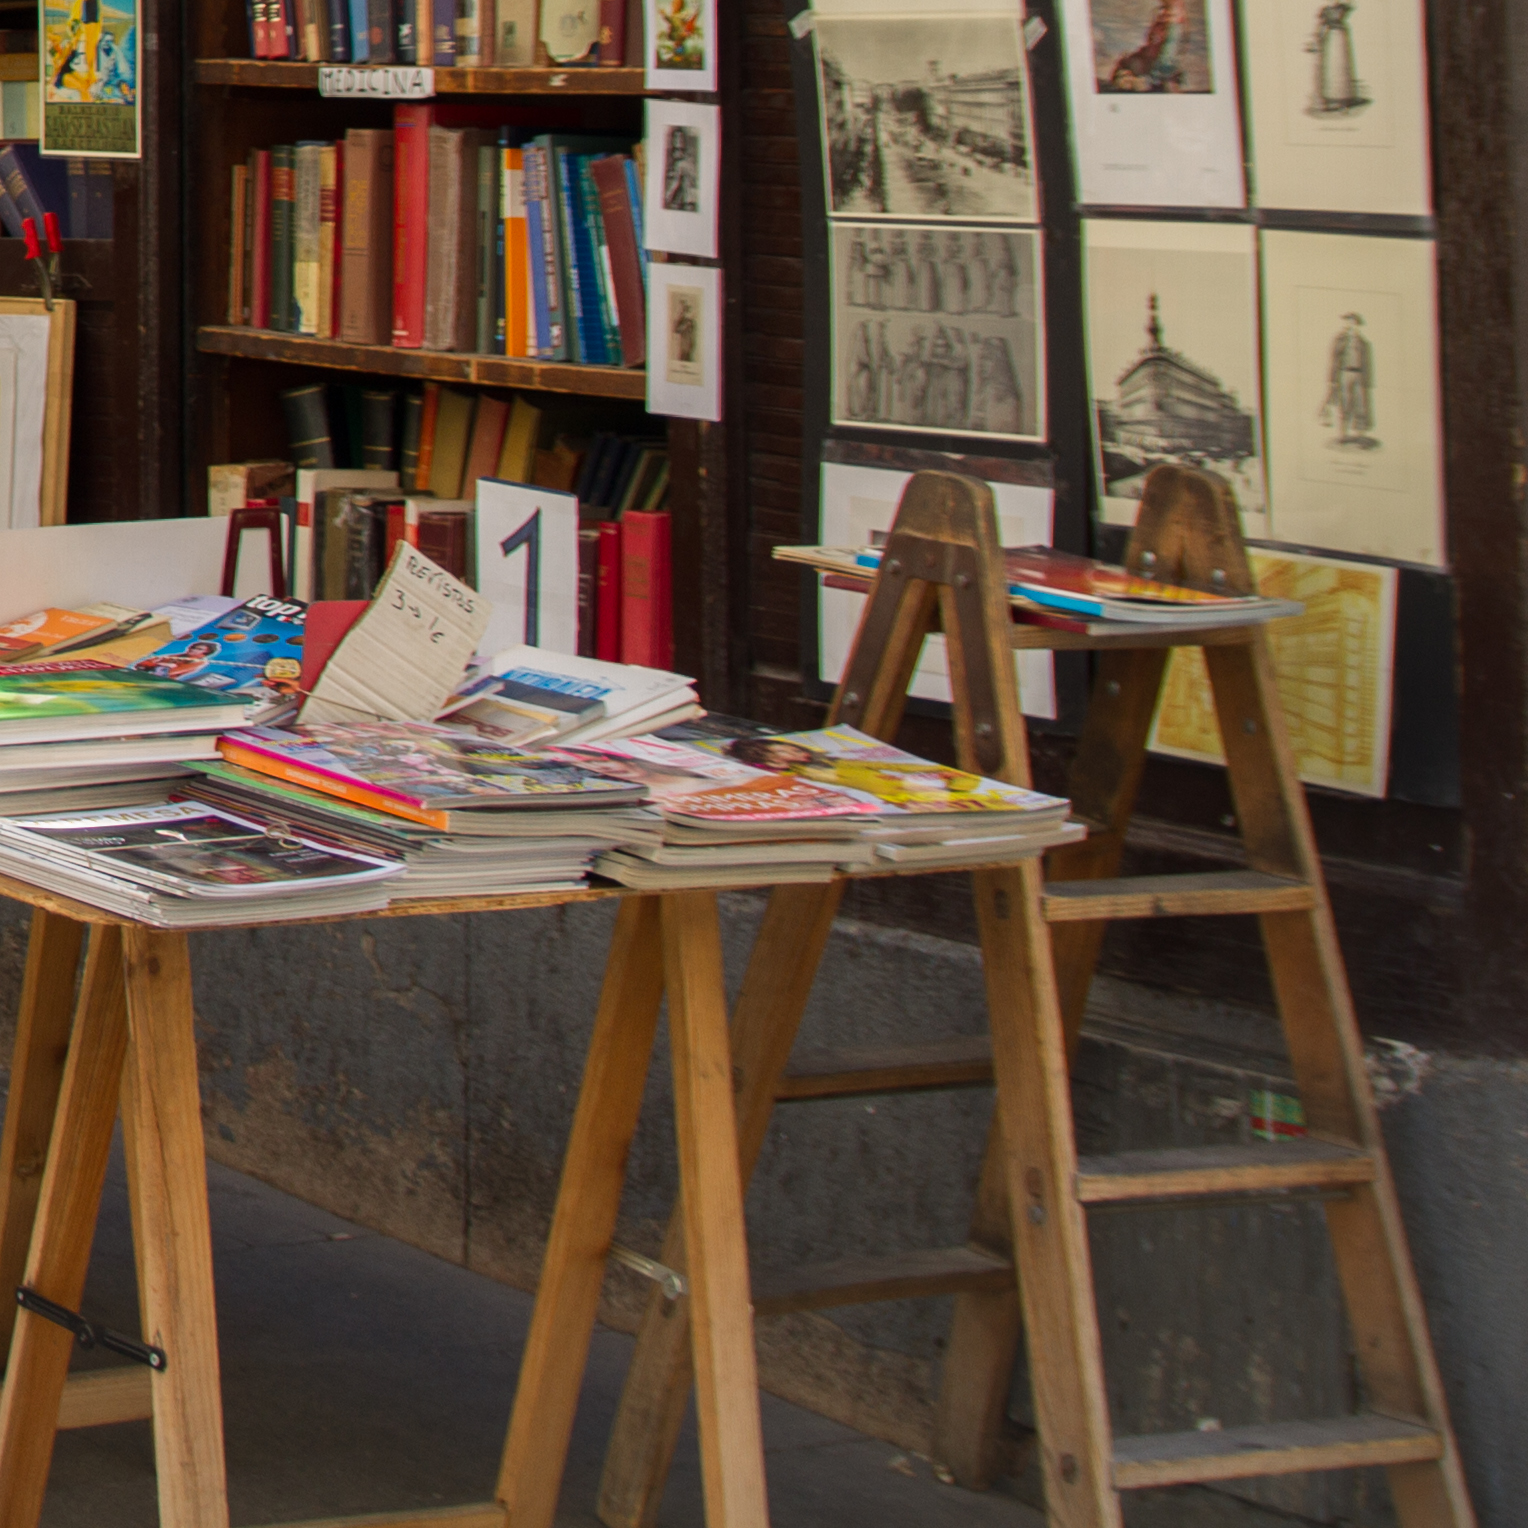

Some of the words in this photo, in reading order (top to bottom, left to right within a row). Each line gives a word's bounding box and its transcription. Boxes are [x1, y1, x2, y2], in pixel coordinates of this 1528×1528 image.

[321, 69, 427, 95] MEDICINA
[406, 555, 477, 614] REVISTAS
[499, 508, 541, 648] 1
